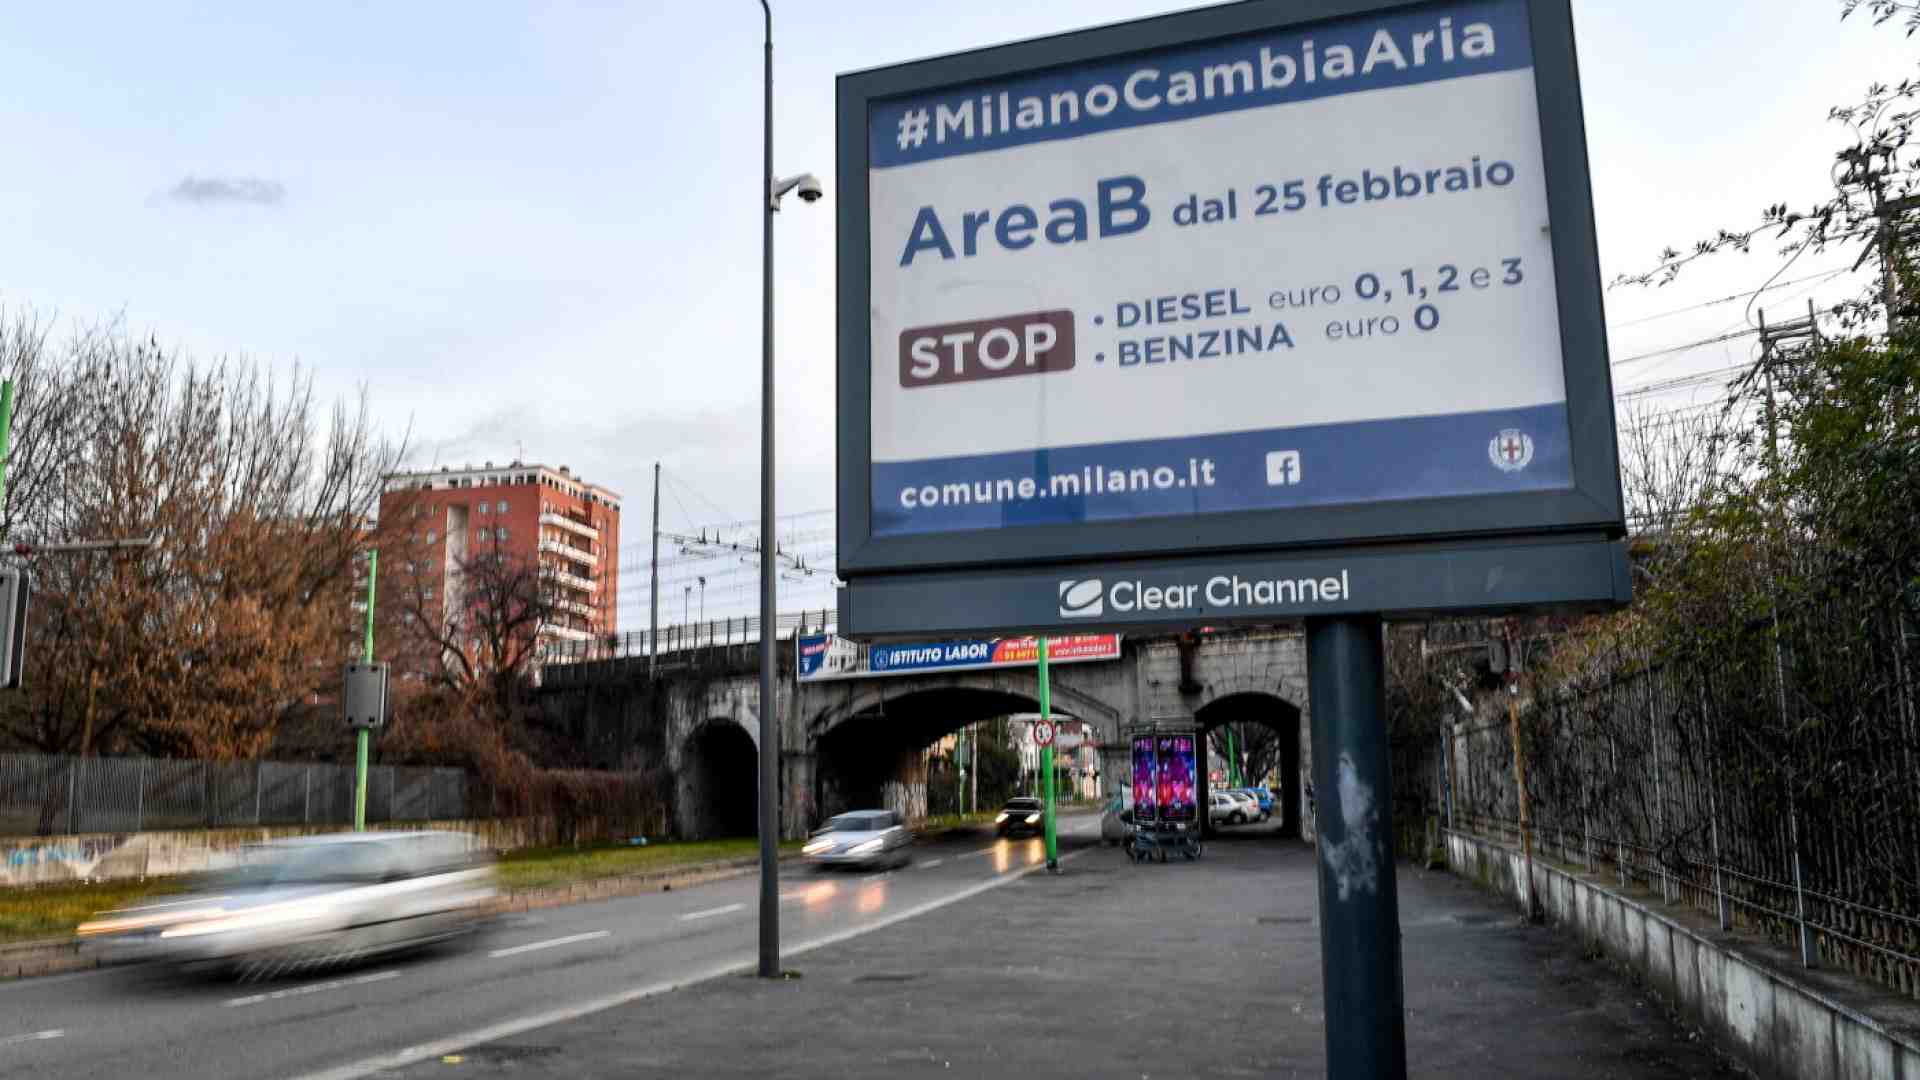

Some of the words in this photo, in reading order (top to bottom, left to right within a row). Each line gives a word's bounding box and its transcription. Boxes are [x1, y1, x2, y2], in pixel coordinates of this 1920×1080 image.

[897, 17, 1497, 149] #MilanoCambiaAria
[900, 175, 1150, 266] AreaB
[1172, 189, 1237, 226] dal
[1255, 179, 1306, 217] 25
[1317, 155, 1515, 207] febbraio
[1116, 289, 1251, 328] DIESEL
[1269, 282, 1341, 310] euro
[1470, 266, 1491, 289] e
[1502, 257, 1524, 286] 3
[909, 322, 1057, 379] STOP
[1118, 322, 1294, 366] BENZINA
[1325, 314, 1400, 340] euro
[1414, 304, 1440, 331] 0
[900, 457, 1216, 509] comune.milano.it
[1110, 580, 1198, 611] Clear
[1205, 570, 1350, 608] Channel
[889, 647, 942, 666] ISTITUTO
[944, 643, 988, 661] LABOR
